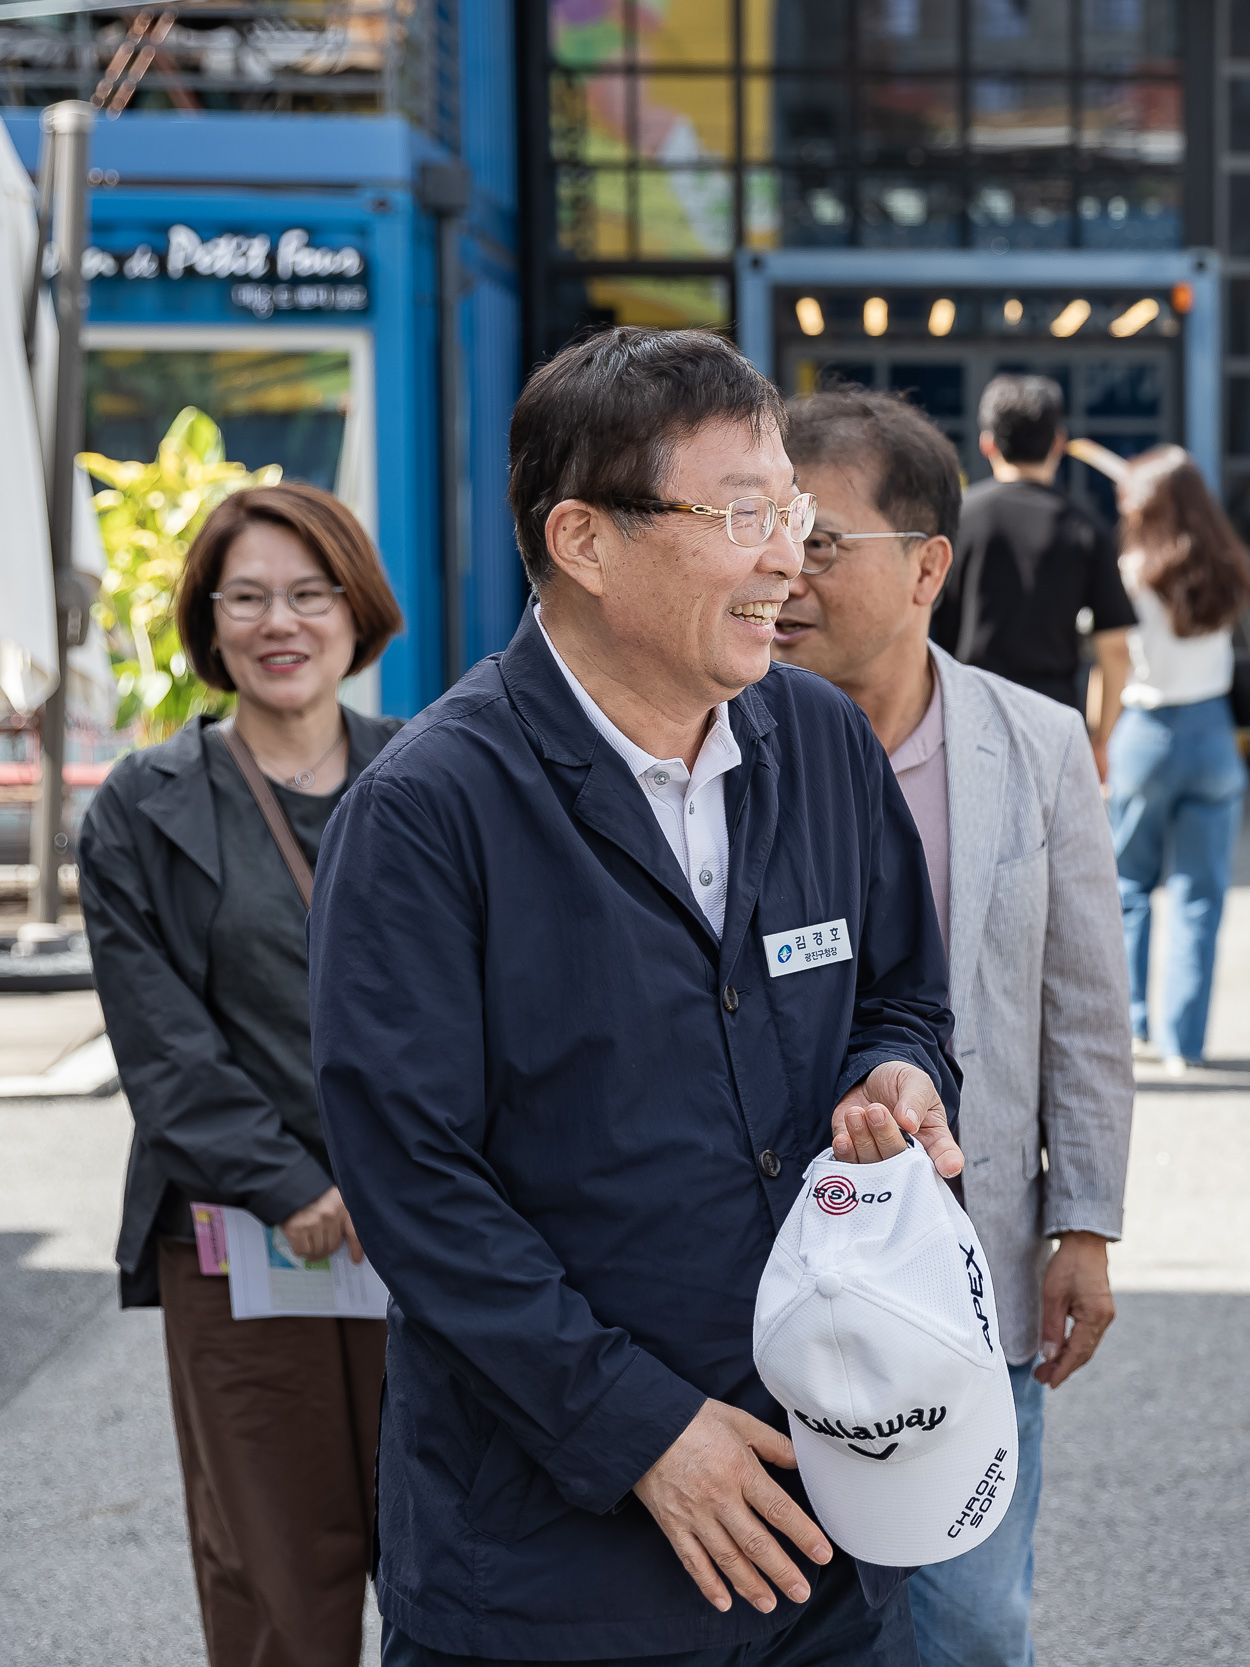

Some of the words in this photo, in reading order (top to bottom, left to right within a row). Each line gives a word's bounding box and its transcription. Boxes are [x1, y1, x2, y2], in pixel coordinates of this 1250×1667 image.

[168, 224, 271, 279] Petit
[804, 946, 838, 963] 광진구청장
[805, 1186, 892, 1204] ODYSS
[958, 1242, 993, 1353] APEX
[947, 1447, 1008, 1538] CHROME
[969, 1470, 1006, 1529] SOFT
